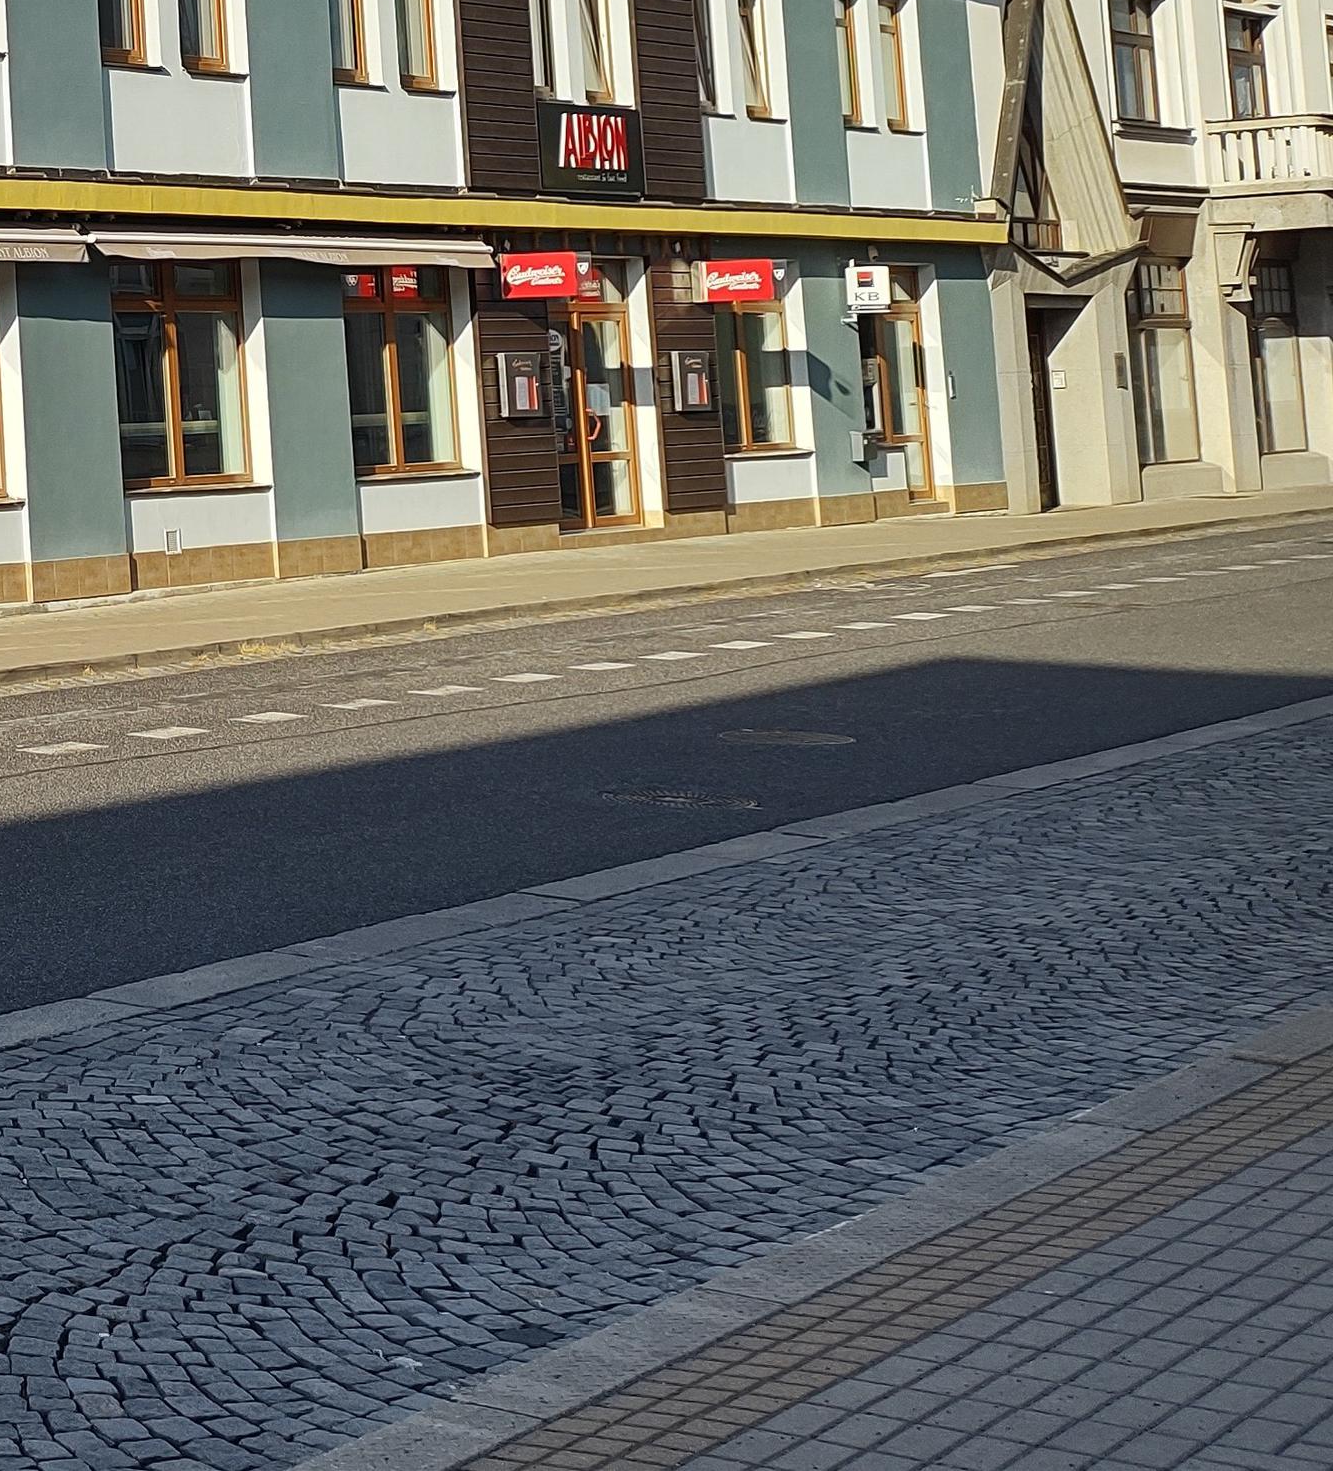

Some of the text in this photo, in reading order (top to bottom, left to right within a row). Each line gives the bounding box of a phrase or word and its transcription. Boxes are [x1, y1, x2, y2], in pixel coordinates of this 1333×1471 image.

[558, 112, 629, 171] ALBION
[13, 246, 50, 259] ALBION
[854, 291, 880, 302] KB
